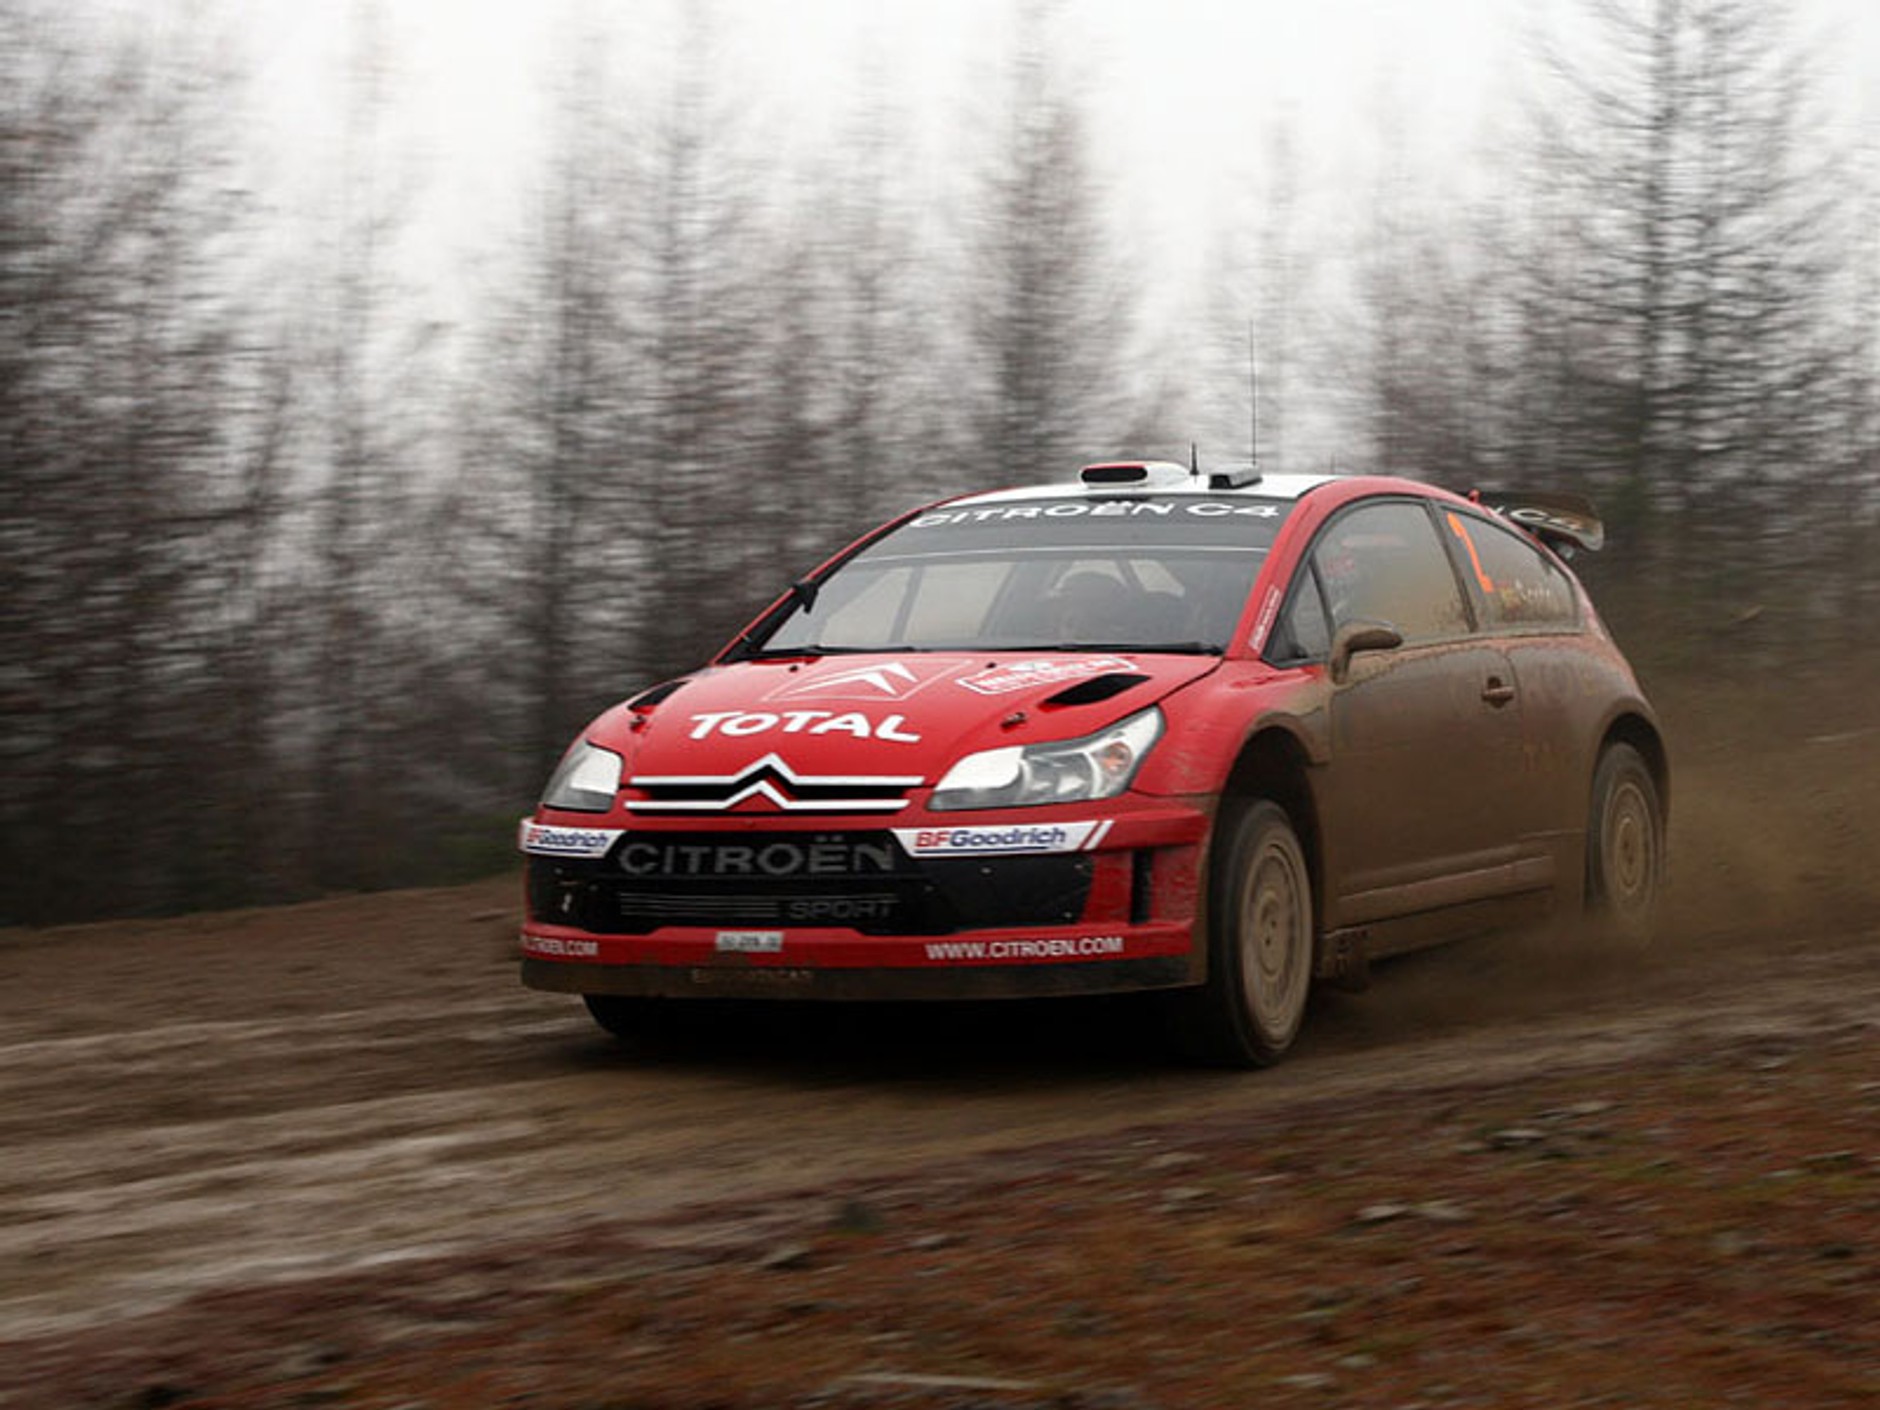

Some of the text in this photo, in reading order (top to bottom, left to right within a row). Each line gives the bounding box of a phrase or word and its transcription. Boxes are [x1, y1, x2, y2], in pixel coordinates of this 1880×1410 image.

[1186, 502, 1280, 519] C4
[688, 710, 921, 743] TOTAL
[915, 827, 1067, 849] BFGoodrich
[617, 834, 897, 875] CITROËN
[788, 899, 894, 921] SPORT
[924, 937, 1124, 961] WWW.CITROEN.COM
